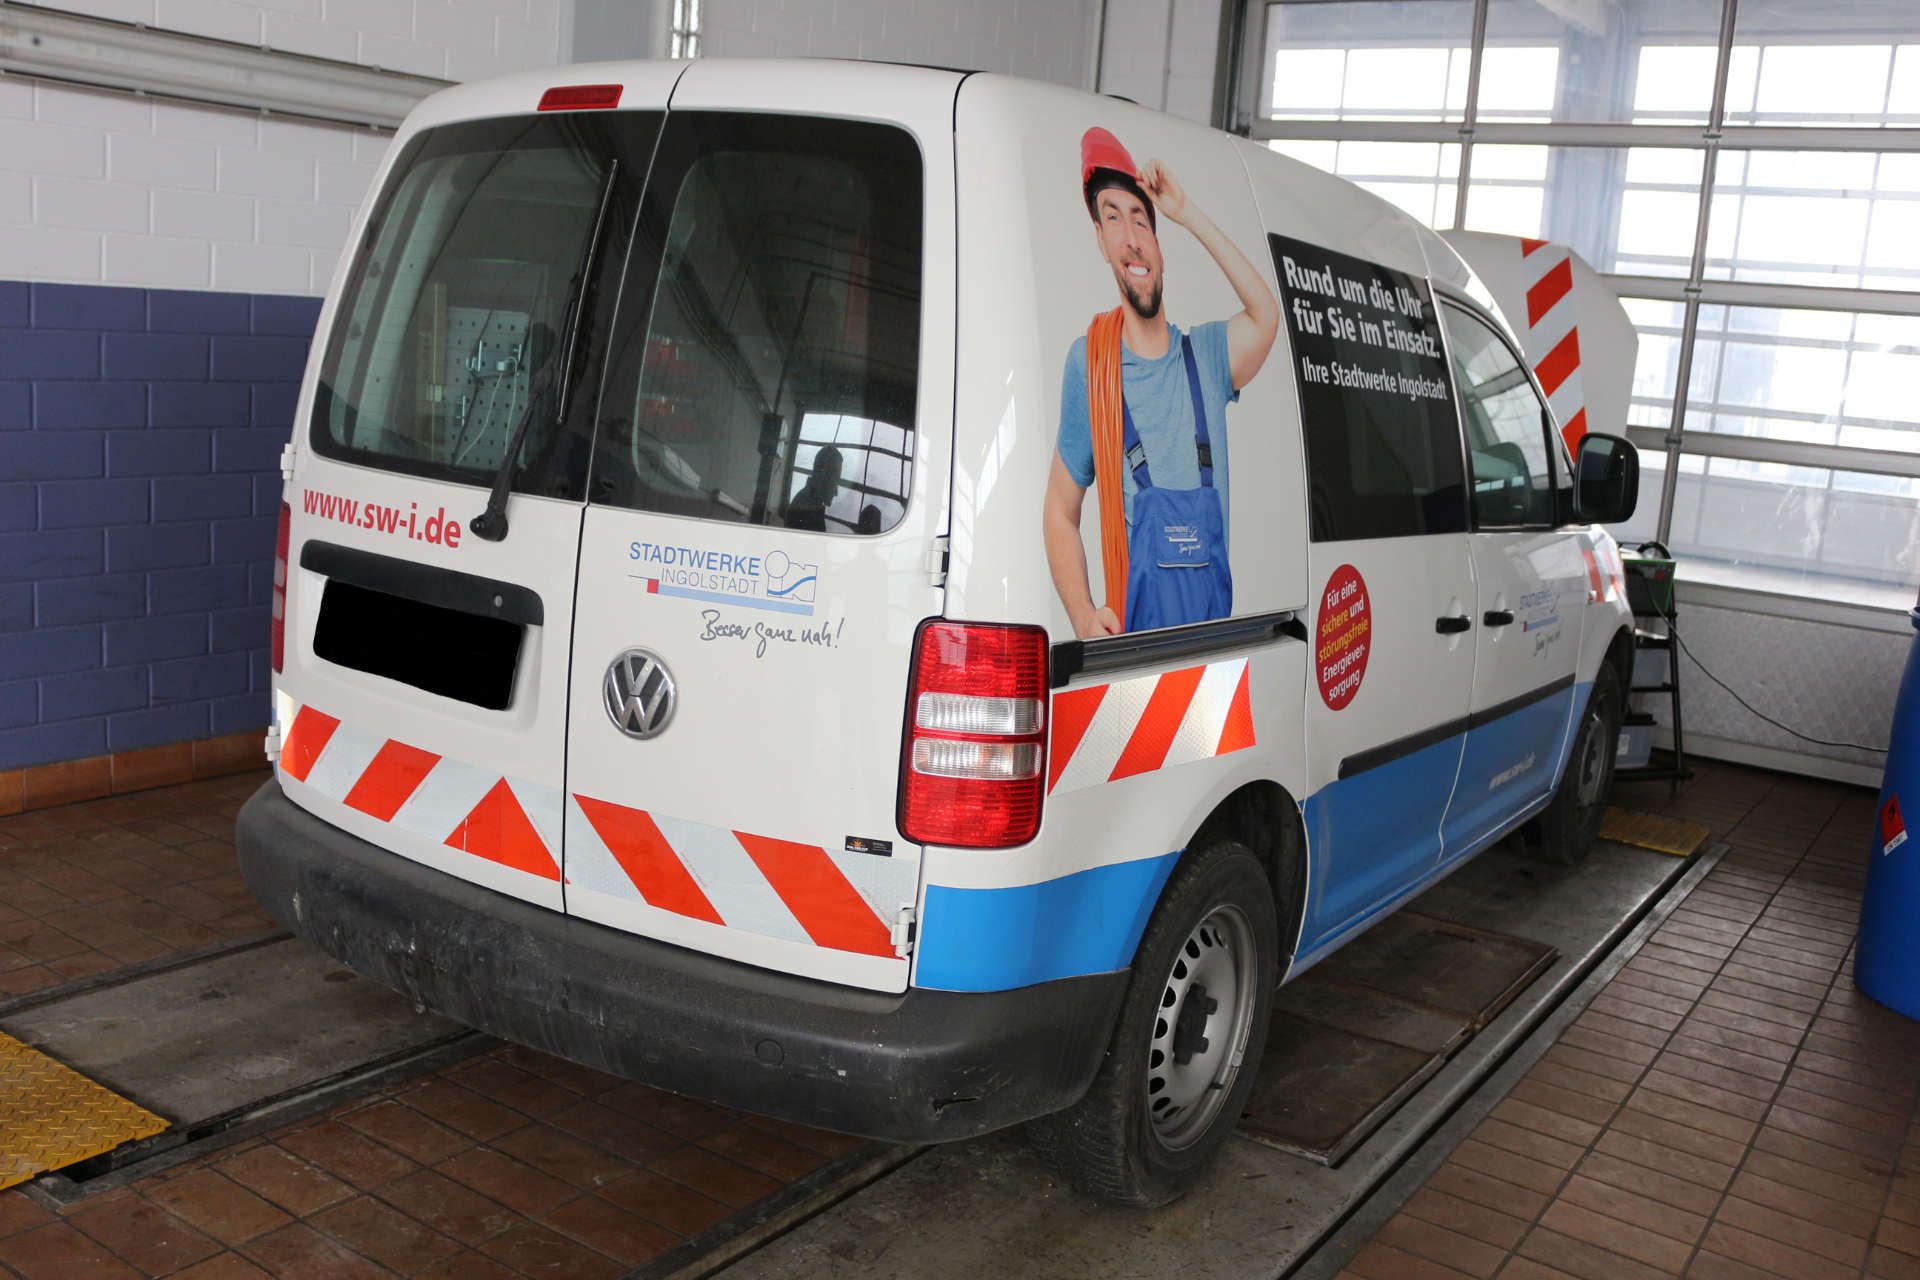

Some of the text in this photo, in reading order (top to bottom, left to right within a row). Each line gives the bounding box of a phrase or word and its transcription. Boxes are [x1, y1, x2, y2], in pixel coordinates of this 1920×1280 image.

[1282, 255, 1423, 319] Rund um die Uhr
[1293, 298, 1440, 358] für Sie im Einsatz.
[1302, 356, 1447, 401] Ihre Stadtwerke Ingolstadt
[304, 489, 461, 548] www.sw-i.de
[629, 542, 761, 576] STADTWERKE
[661, 568, 760, 595] INGOLSTADT
[1327, 580, 1357, 609] Für eine
[1322, 594, 1364, 637] sichere und
[755, 622, 796, 658] ganz
[1319, 617, 1368, 663] störungsfreie
[1323, 644, 1366, 683] Energiever-
[1329, 669, 1360, 702] sorgung
